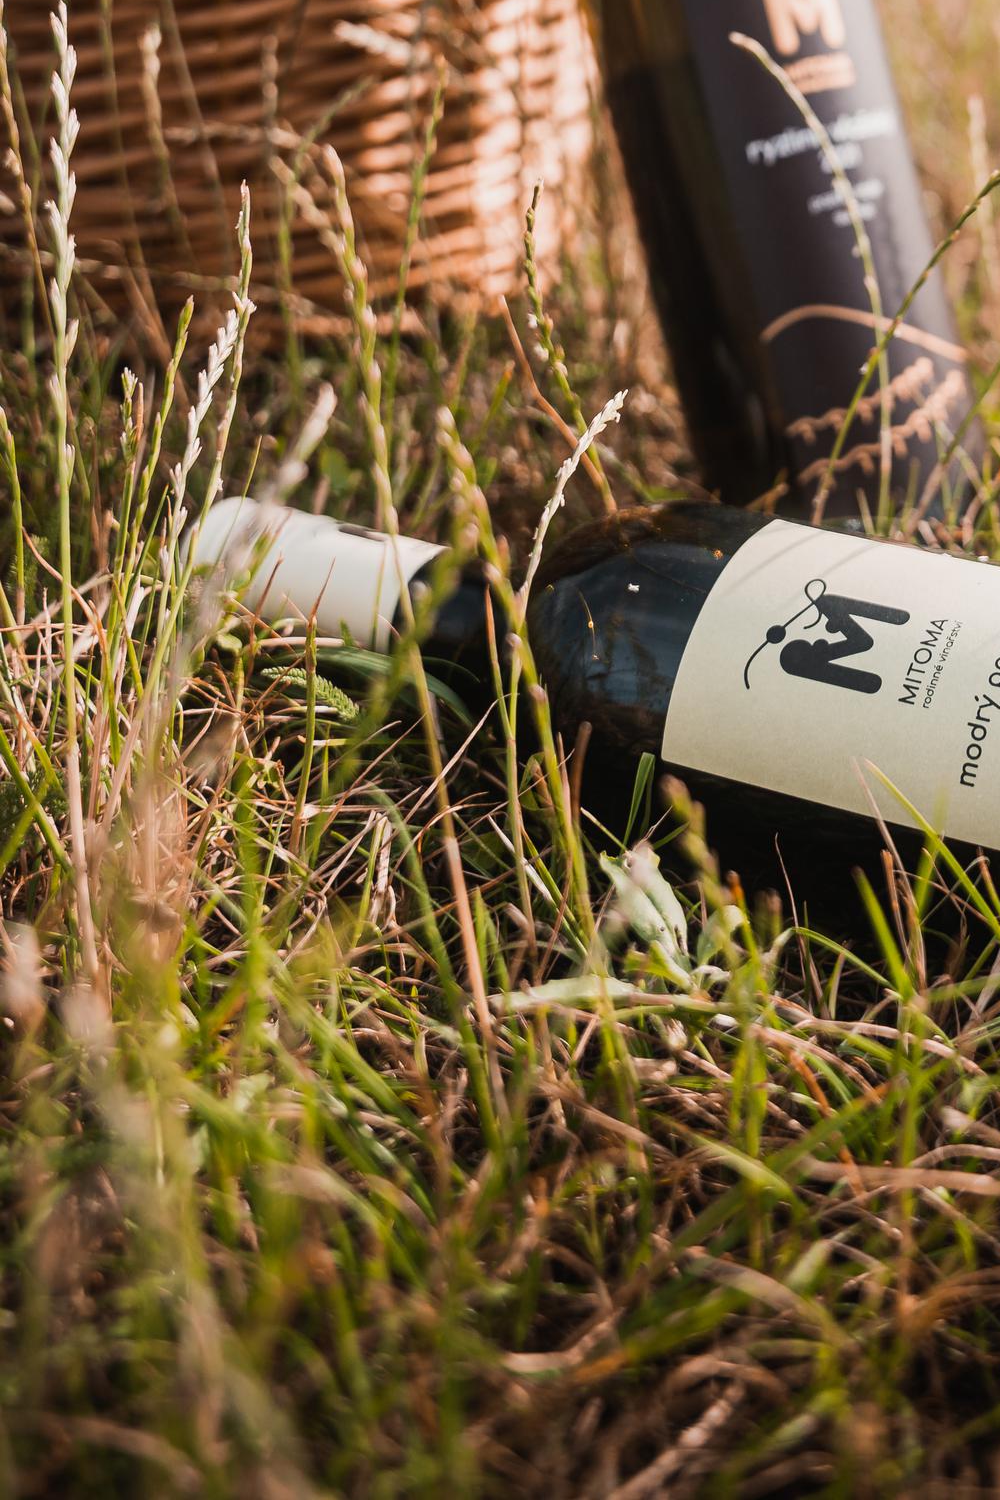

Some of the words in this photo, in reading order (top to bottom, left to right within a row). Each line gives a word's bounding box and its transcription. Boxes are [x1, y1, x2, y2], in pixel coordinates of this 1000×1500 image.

[898, 619, 949, 706] MITOMA
[922, 664, 944, 709] rodinné
[939, 620, 964, 663] vinařství
[959, 692, 1000, 788] modrý
